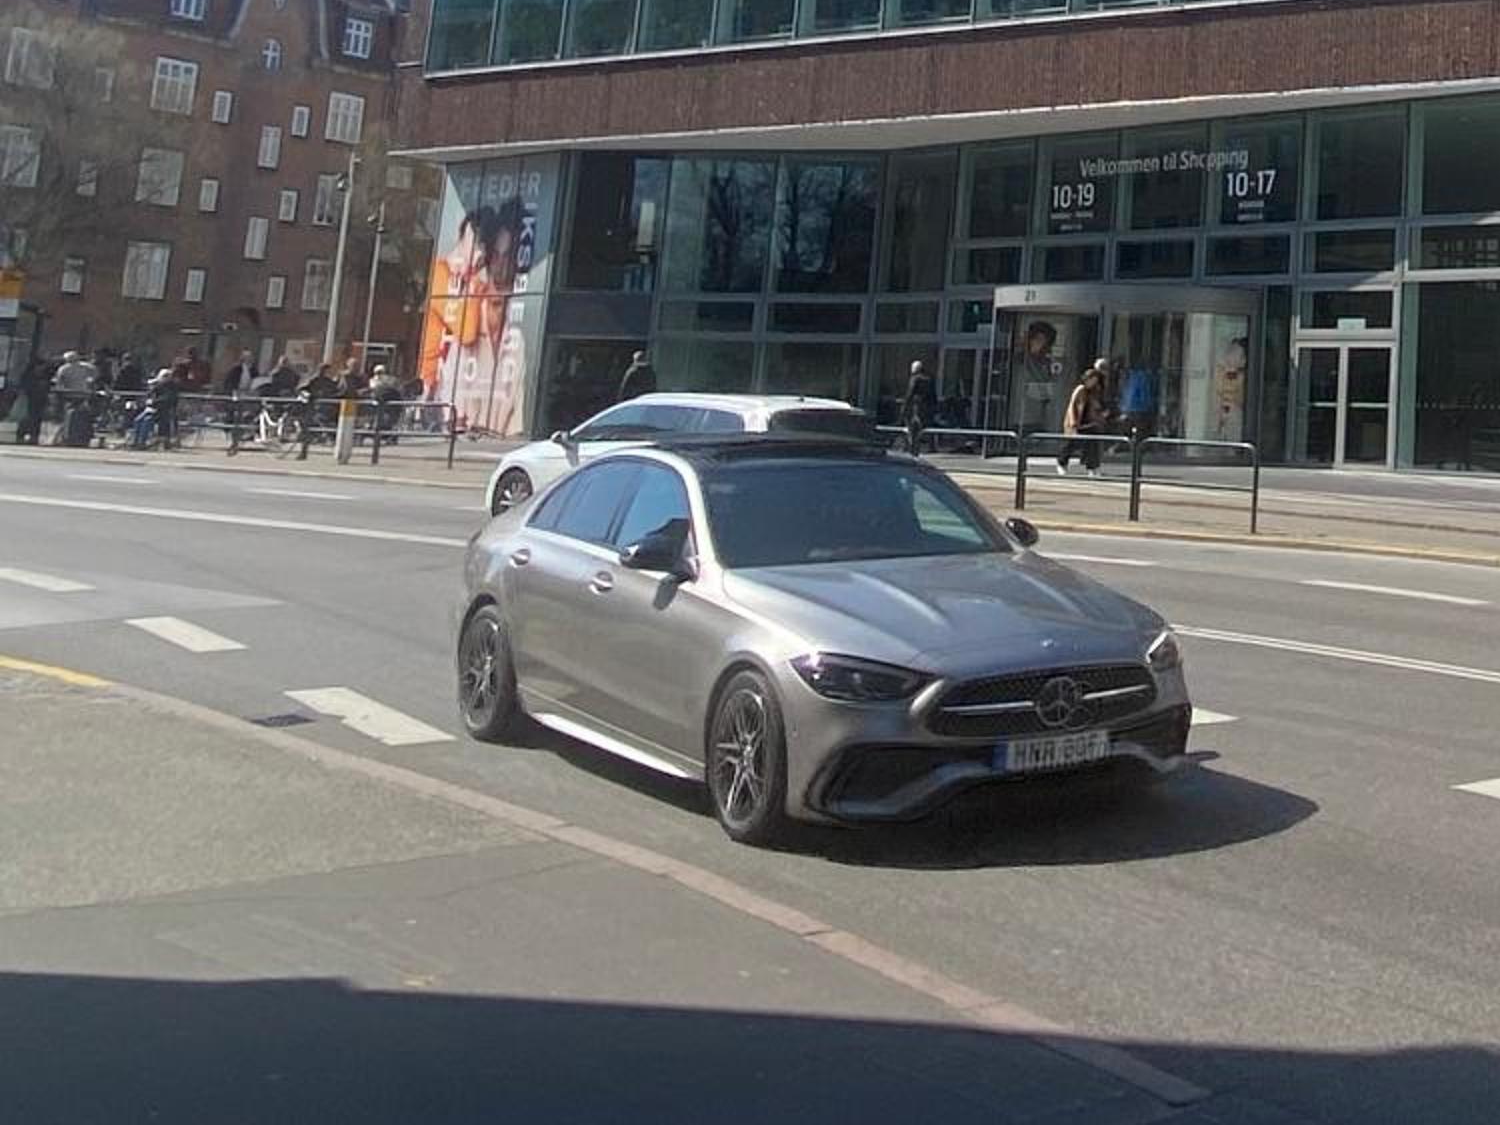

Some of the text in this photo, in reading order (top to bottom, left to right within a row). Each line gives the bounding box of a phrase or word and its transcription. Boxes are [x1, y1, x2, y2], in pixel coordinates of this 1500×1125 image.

[1080, 150, 1249, 177] Velkommen til Shopping
[1053, 182, 1095, 209] 10-19
[1226, 169, 1277, 197] 10-17
